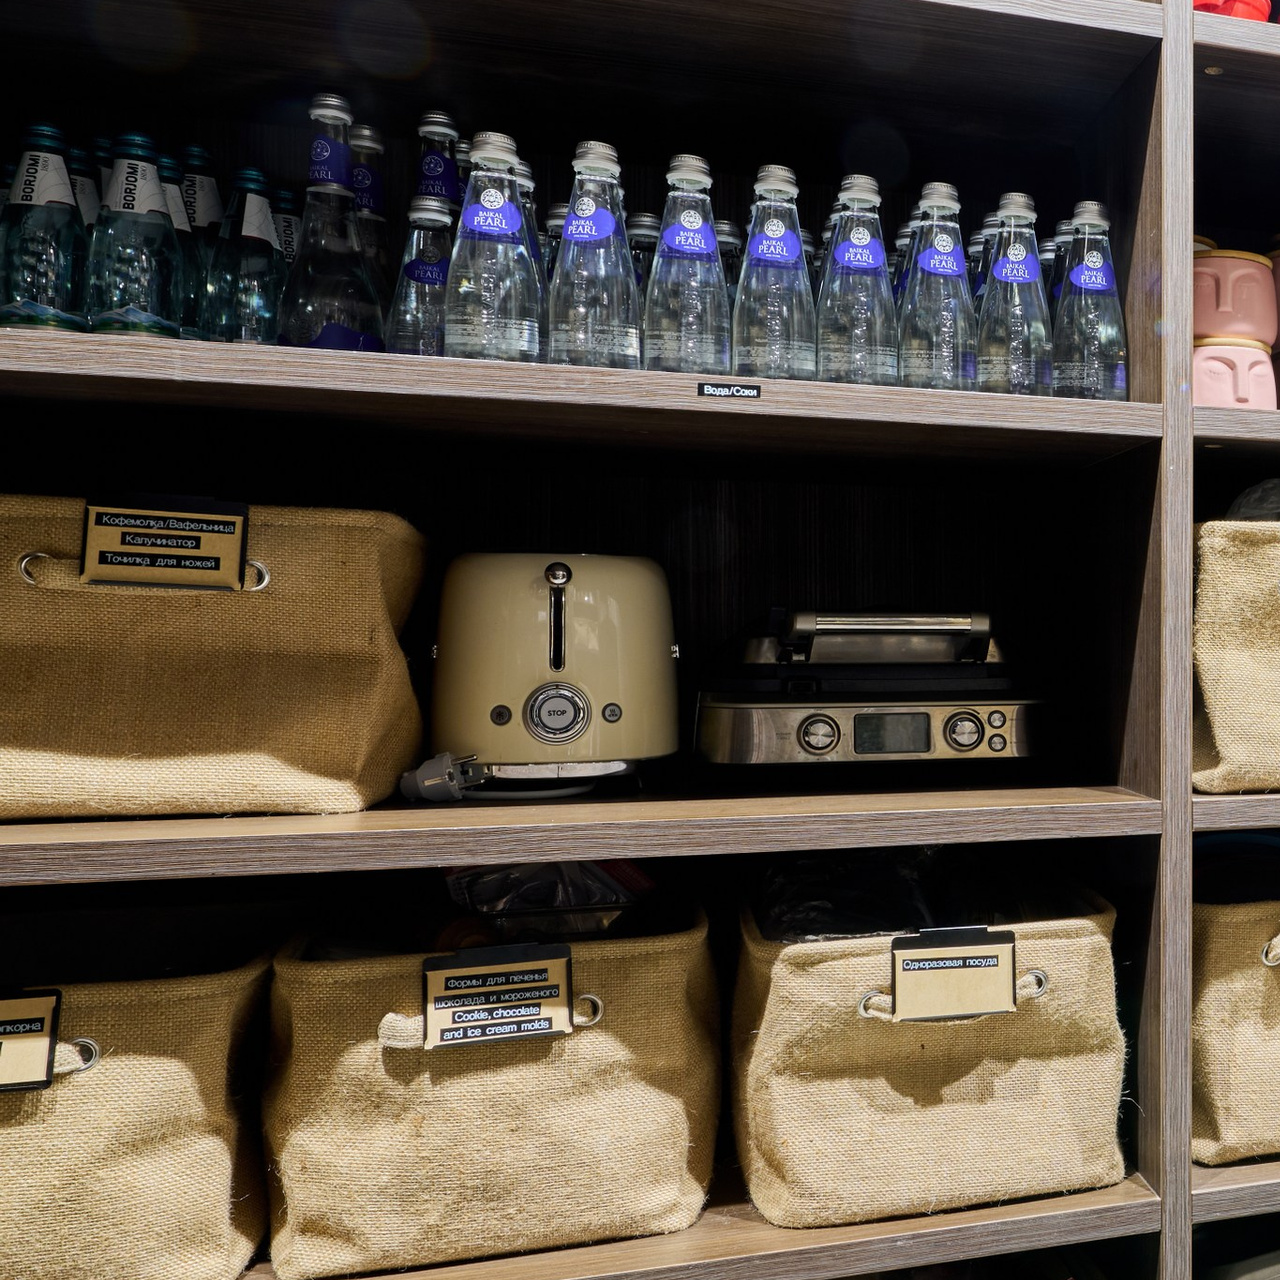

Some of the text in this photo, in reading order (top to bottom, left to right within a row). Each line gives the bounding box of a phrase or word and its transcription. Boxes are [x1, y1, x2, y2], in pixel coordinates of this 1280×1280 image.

[21, 154, 41, 202] BORJOMI
[122, 162, 140, 211] BORJOMI
[479, 211, 504, 219] BAIKAL
[474, 216, 508, 229] PEARL
[572, 219, 593, 227] BAIKAL
[568, 225, 598, 235] PEARL
[680, 231, 702, 239] BAIKAL
[675, 237, 706, 248] PEARL
[763, 239, 784, 247] BAIKAL
[758, 245, 788, 256] PEARL
[849, 247, 870, 255] BAIKAL
[845, 253, 875, 263] PEARL
[934, 254, 954, 262] BAIKAL
[930, 260, 959, 271] PEARL
[1006, 263, 1026, 271] BAIKAL
[1002, 268, 1030, 278] PEARL
[1080, 275, 1108, 286] PEARL
[703, 384, 758, 397] Вода/Соки
[102, 515, 234, 533] Кофемолка/Вафельница
[125, 534, 196, 548] Капучинатор
[105, 553, 215, 568] Точилка для ножей
[547, 709, 567, 717] STOP
[903, 957, 997, 970] Одноразовая посуда
[447, 972, 548, 989] Формы для печенья
[435, 996, 485, 1008] шоколада
[500, 988, 559, 1001] мороженого
[454, 1006, 540, 1022] Cookie, chocolate
[0, 1022, 42, 1034] пкорна
[443, 1019, 550, 1040] and ice cream molds
